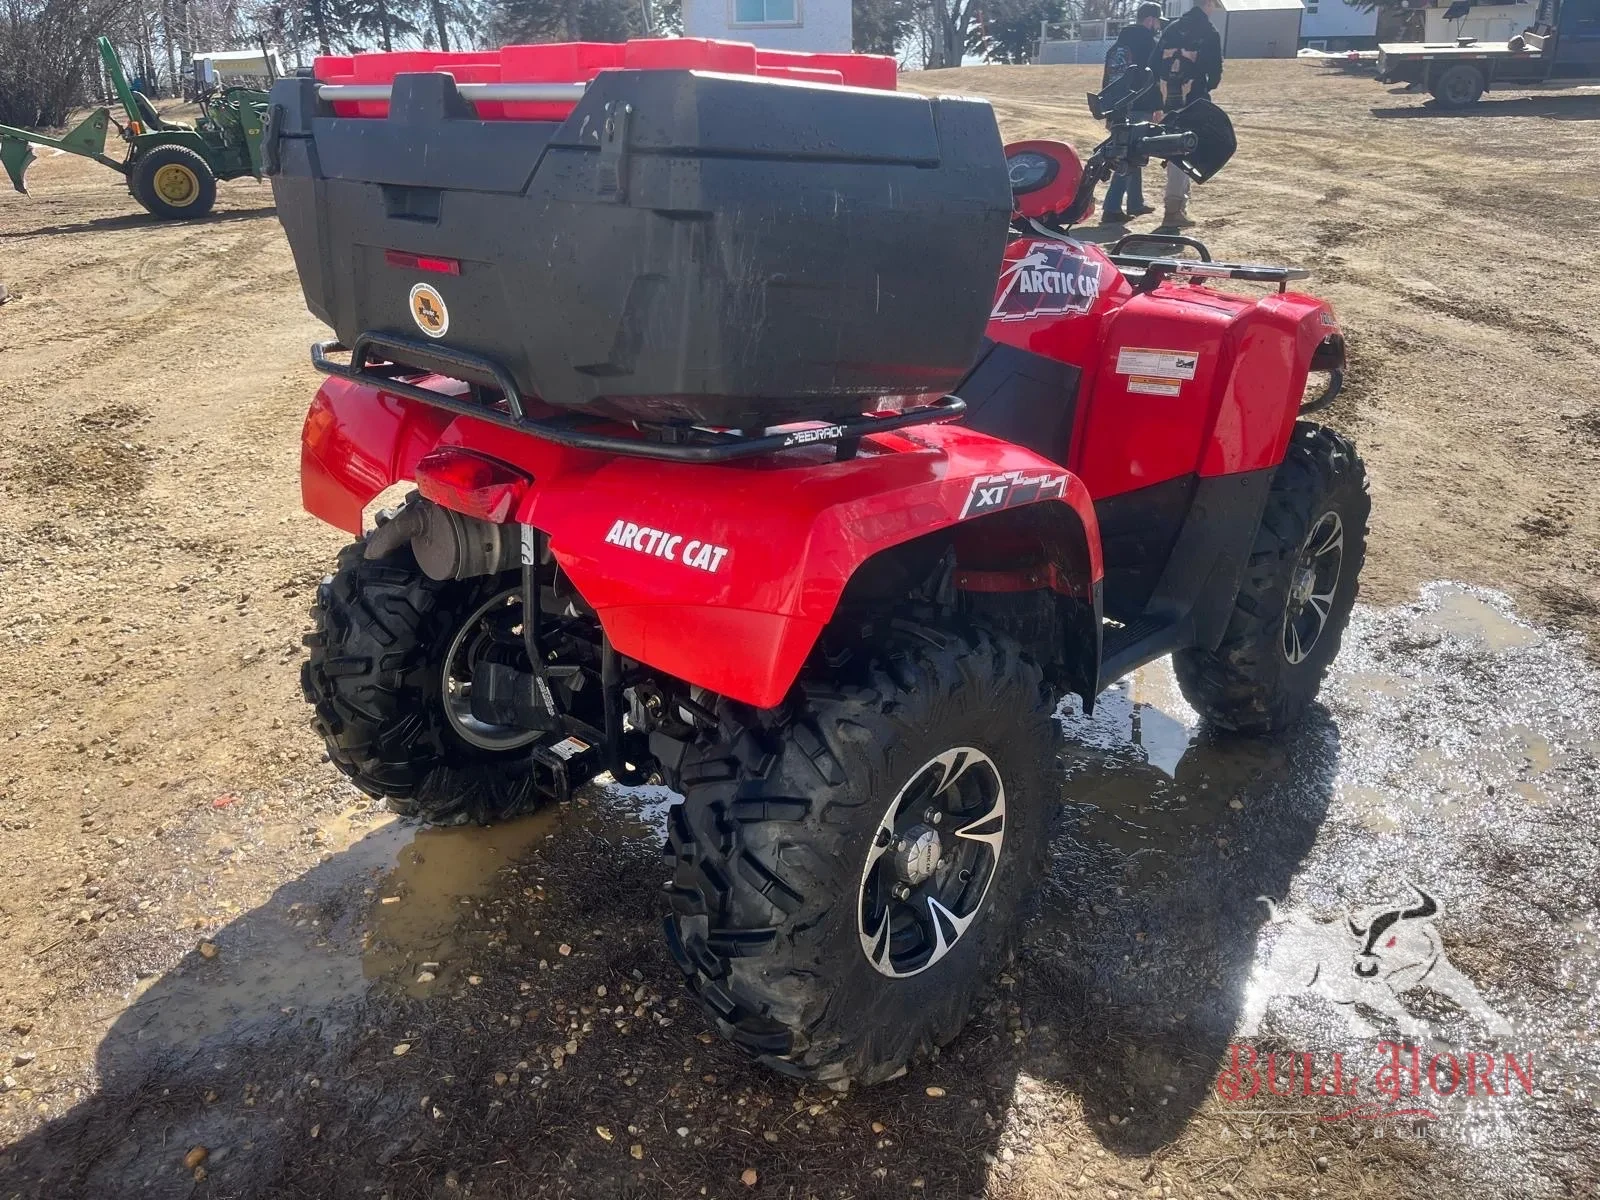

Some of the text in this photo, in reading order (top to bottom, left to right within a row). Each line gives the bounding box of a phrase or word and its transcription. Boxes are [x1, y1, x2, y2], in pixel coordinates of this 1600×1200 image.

[1020, 270, 1099, 299] ARCTIC CAT
[976, 485, 1009, 507] XT
[604, 519, 729, 573] ARCTIC CAT
